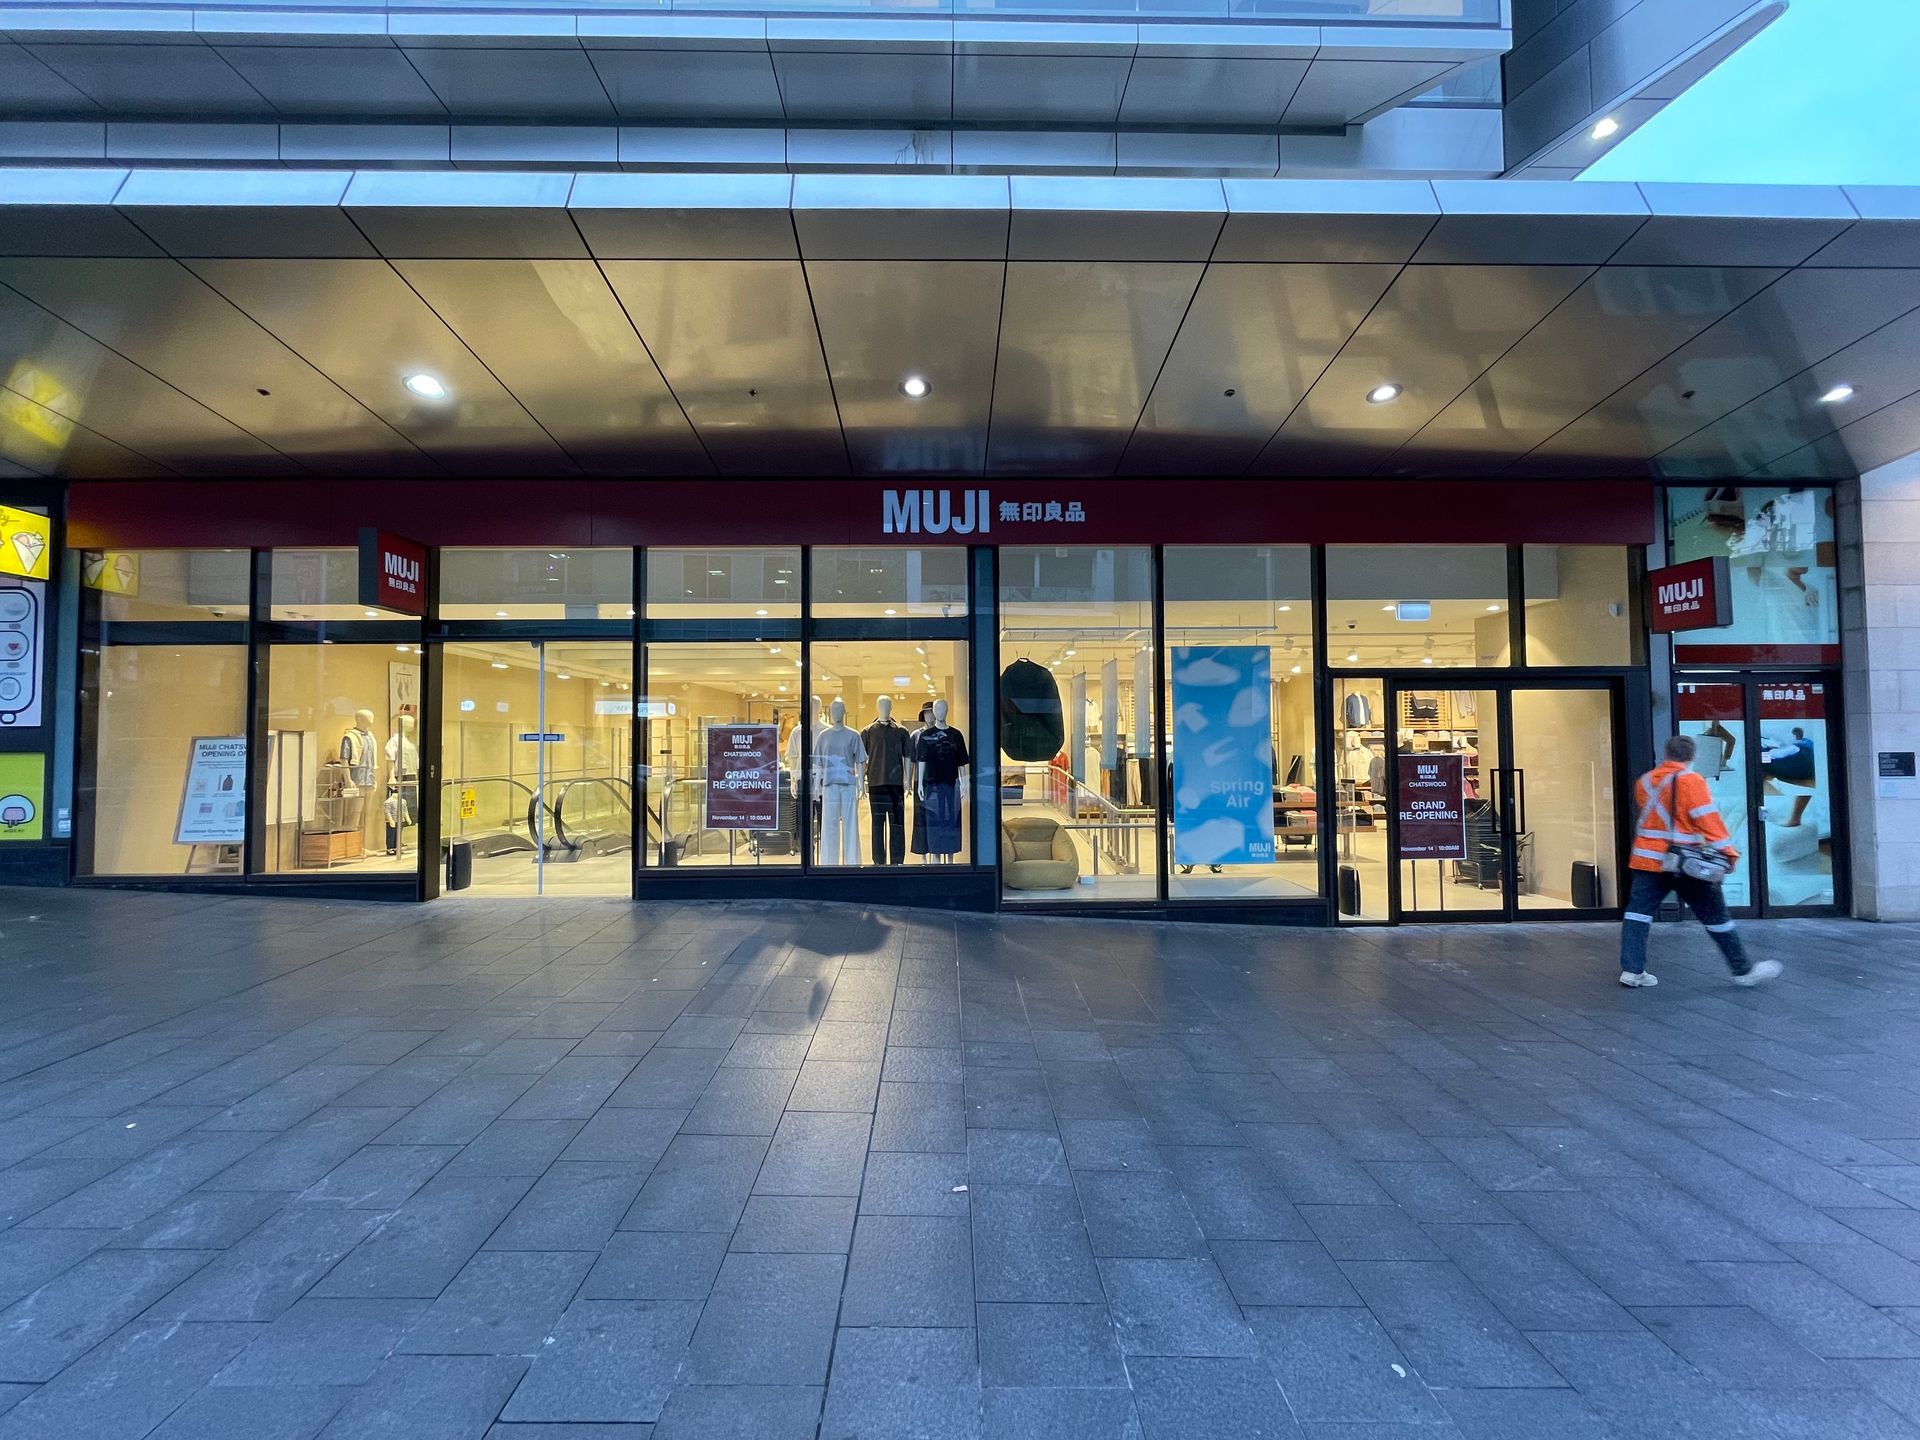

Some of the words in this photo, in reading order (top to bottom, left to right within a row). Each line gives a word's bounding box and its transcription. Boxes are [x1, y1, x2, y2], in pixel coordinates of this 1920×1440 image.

[883, 490, 990, 534] MUJI
[999, 501, 1085, 522] 無印良品
[385, 552, 419, 582] MUJI
[1659, 578, 1703, 604] MUJI
[732, 735, 752, 744] MUJI
[1418, 765, 1437, 774] MUJI
[725, 771, 759, 779] GRAND
[713, 781, 772, 789] RE-OPENING
[1210, 780, 1264, 795] Spring
[1226, 795, 1250, 808] Air
[1412, 801, 1445, 810] GRAND
[1400, 811, 1458, 820] RE-OPENING
[1249, 843, 1270, 852] MUJI
